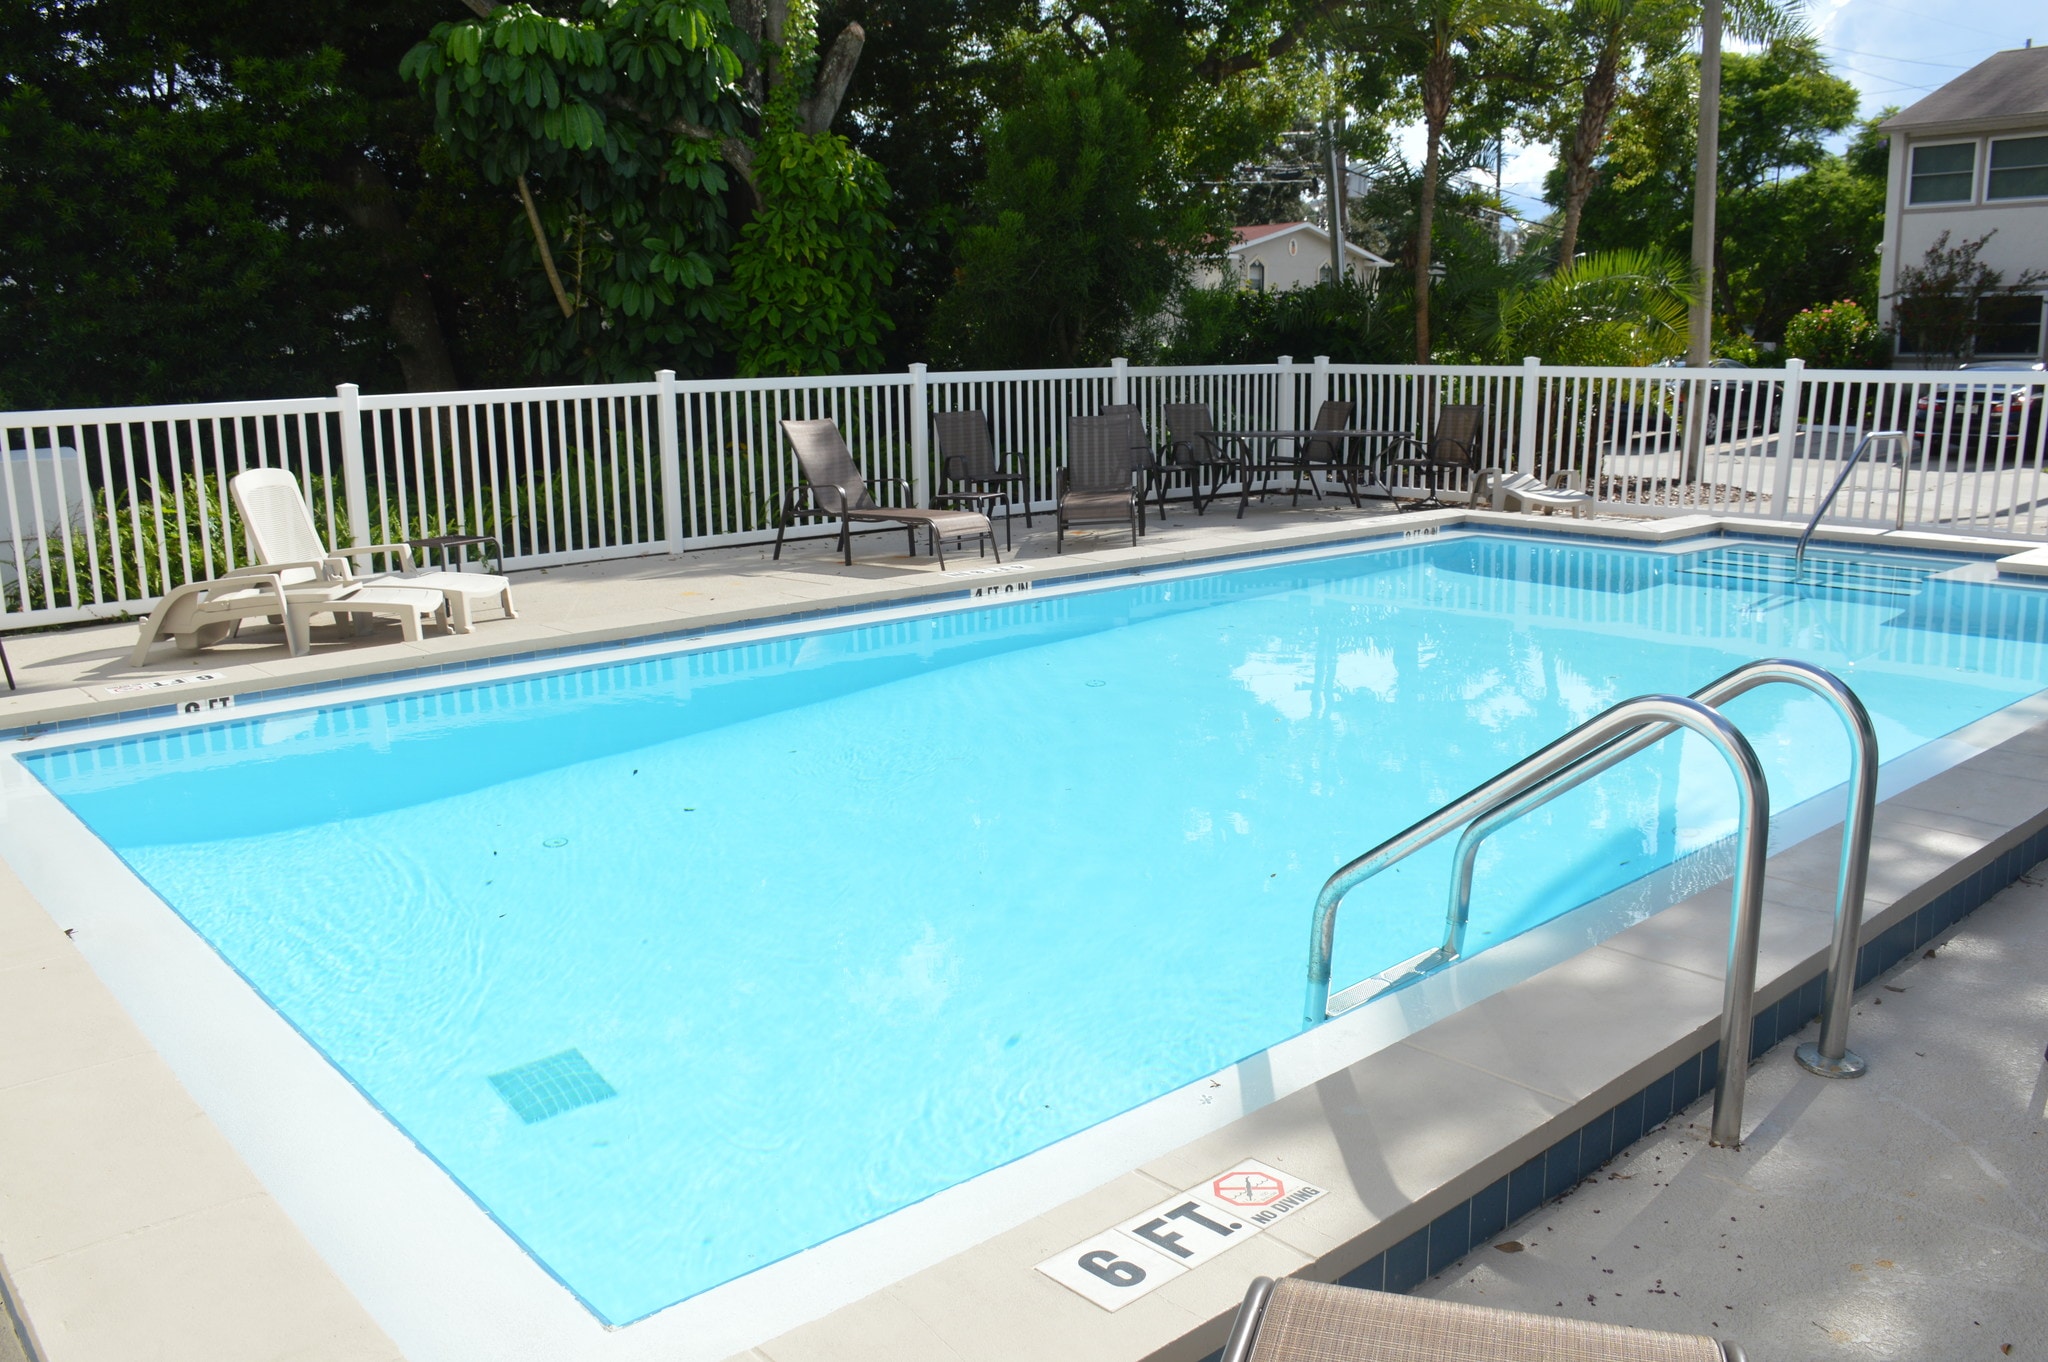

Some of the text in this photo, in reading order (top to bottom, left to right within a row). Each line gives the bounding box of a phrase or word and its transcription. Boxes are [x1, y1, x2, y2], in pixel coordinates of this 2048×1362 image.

[1251, 1186, 1321, 1225] NO DIVING
[1078, 1201, 1242, 1287] 6 FT.
